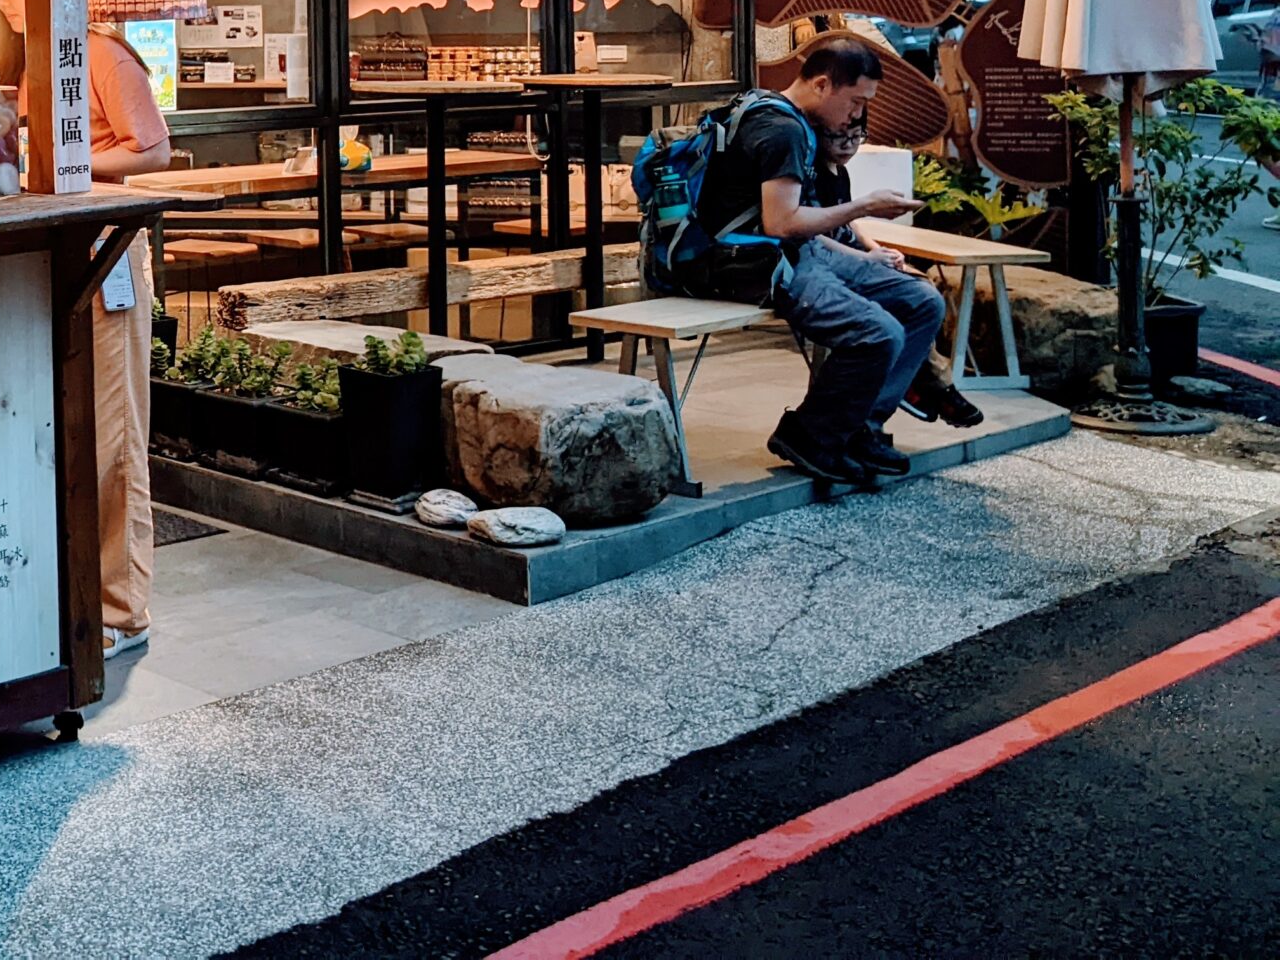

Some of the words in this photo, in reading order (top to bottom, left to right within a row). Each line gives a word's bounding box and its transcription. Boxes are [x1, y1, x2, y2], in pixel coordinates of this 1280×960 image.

[59, 37, 83, 147] 點單區
[57, 165, 89, 176] ORDER
